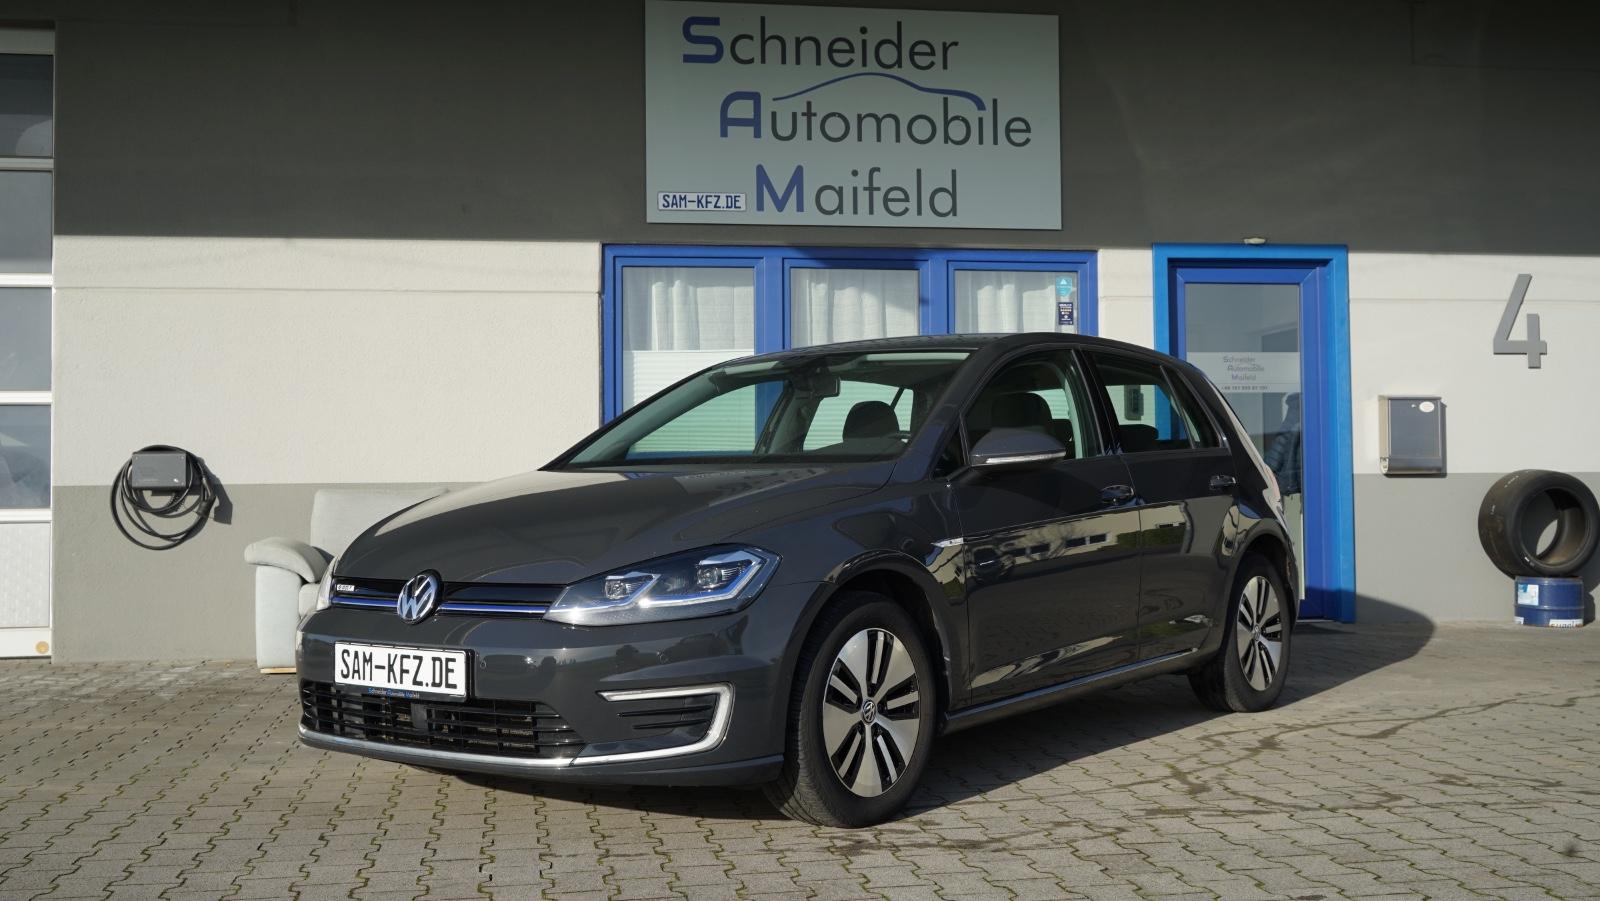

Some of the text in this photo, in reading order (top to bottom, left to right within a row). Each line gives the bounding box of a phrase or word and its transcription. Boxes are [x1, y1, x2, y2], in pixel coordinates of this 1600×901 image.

[682, 15, 959, 71] Schneider
[719, 91, 1032, 147] Automobile
[662, 194, 742, 210] SAM-KFZ.DE
[755, 163, 958, 218] Maifeld
[1493, 273, 1548, 369] 4
[340, 649, 457, 689] SAM-KFZ.DE
